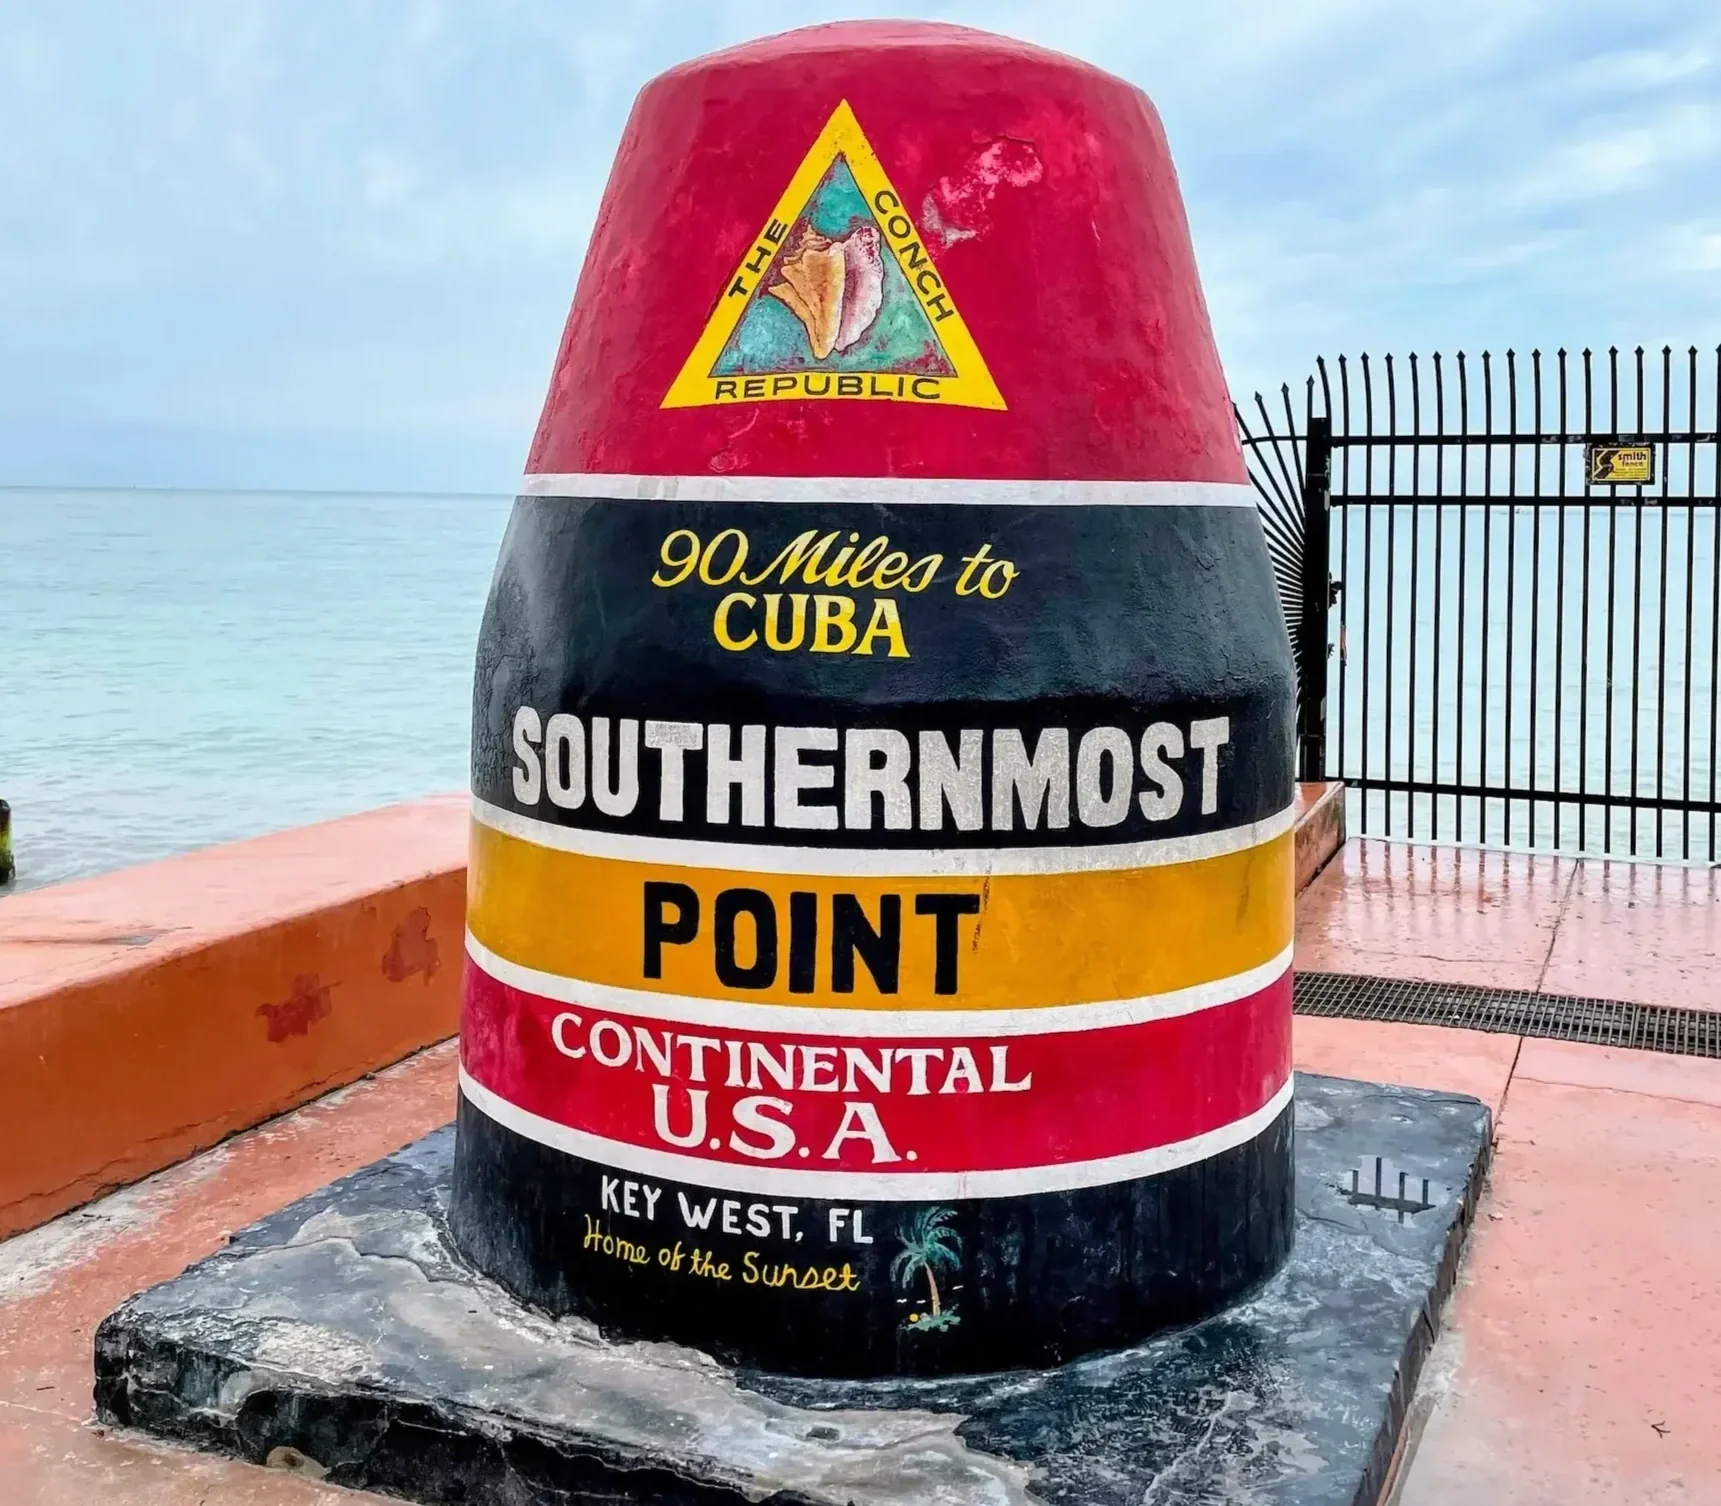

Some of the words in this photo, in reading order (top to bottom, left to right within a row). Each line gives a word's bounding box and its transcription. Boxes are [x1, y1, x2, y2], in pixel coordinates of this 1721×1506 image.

[728, 219, 788, 300] THE
[874, 190, 954, 323] CONCH
[715, 375, 941, 400] REPUBLIC
[1618, 452, 1647, 461] smith
[652, 528, 749, 587] 90
[740, 529, 944, 593] Miles
[955, 543, 1020, 599] to
[713, 592, 911, 658] CUBA
[511, 705, 1230, 834] SOUTHERNMOST
[643, 881, 980, 995] POINT
[551, 1012, 1032, 1095] CONTINENTAL
[651, 1083, 918, 1164] U.S.A.
[601, 1175, 662, 1221] KEY
[677, 1192, 804, 1242] WEST,
[829, 1208, 874, 1244] FL
[583, 1213, 651, 1264] Home
[658, 1241, 686, 1271] of
[688, 1246, 733, 1280] the
[742, 1251, 861, 1292] Sunset
